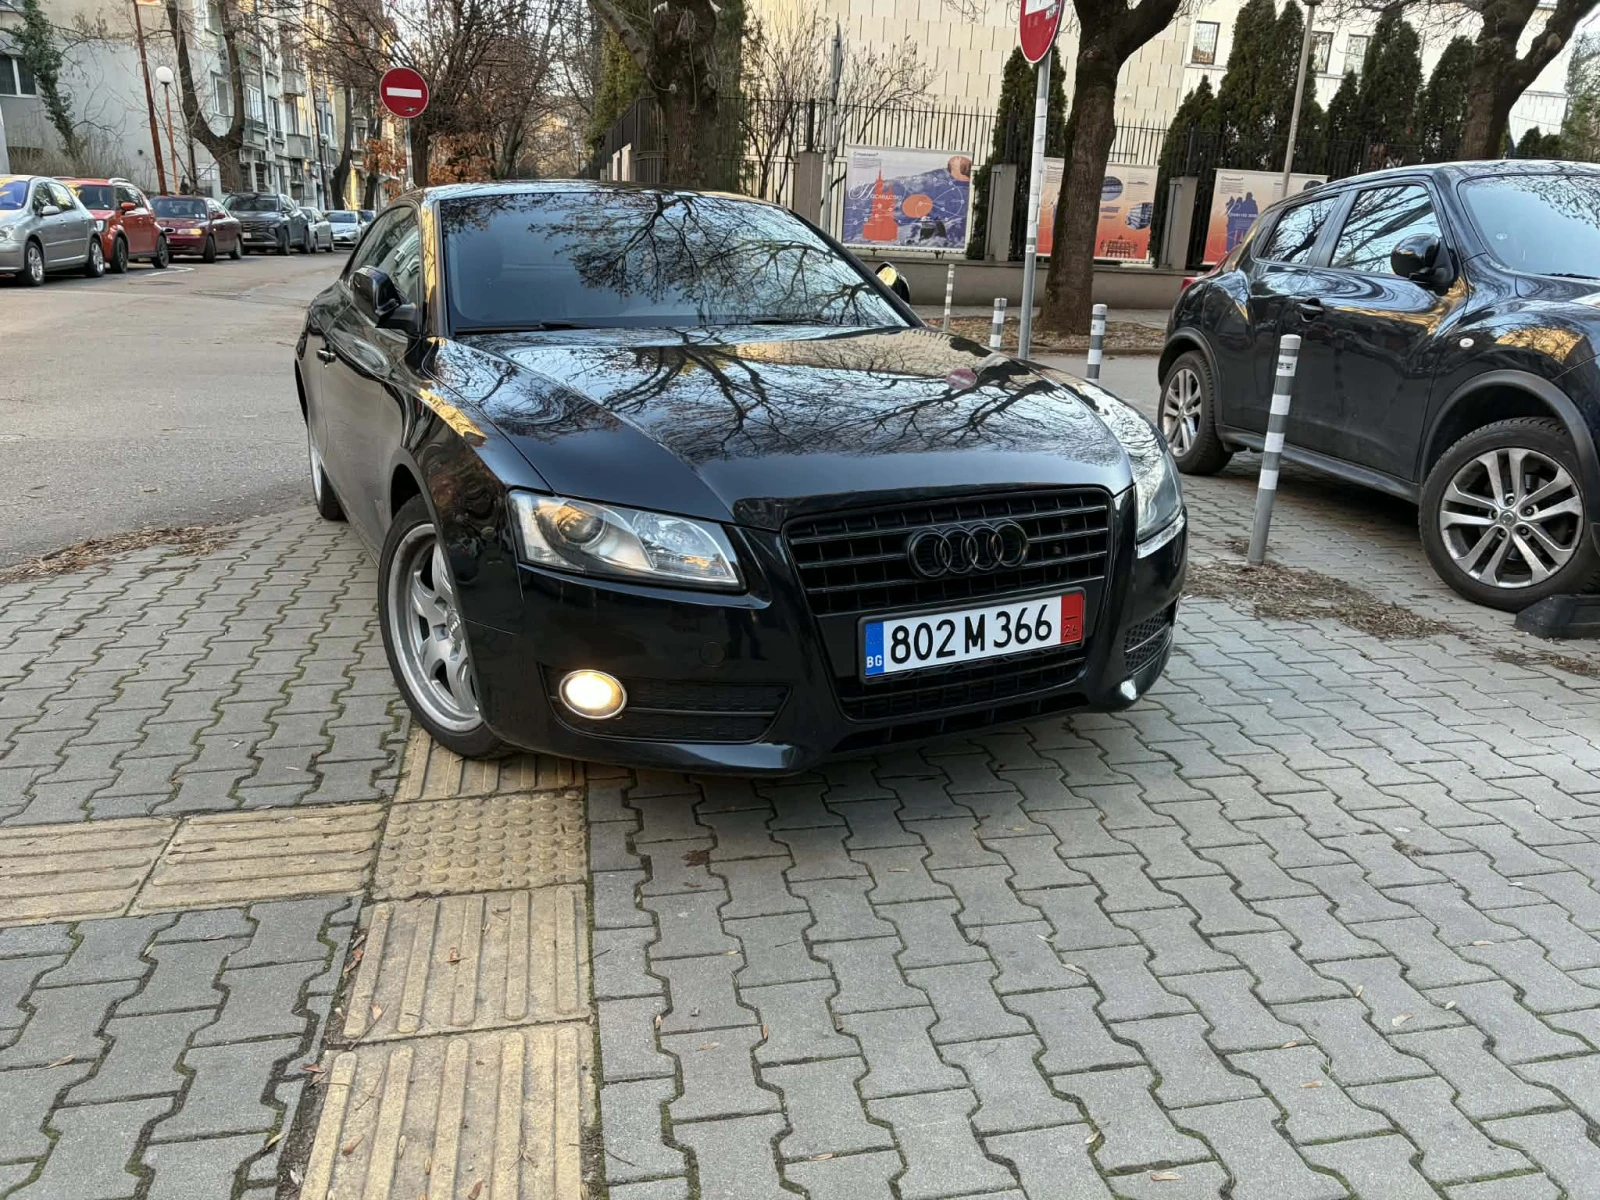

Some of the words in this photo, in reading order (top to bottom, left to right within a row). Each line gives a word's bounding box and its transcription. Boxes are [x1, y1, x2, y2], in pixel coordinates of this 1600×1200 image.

[890, 619, 956, 664] 802
[964, 614, 985, 654] M
[993, 604, 1052, 648] 366
[866, 654, 883, 668] BG
